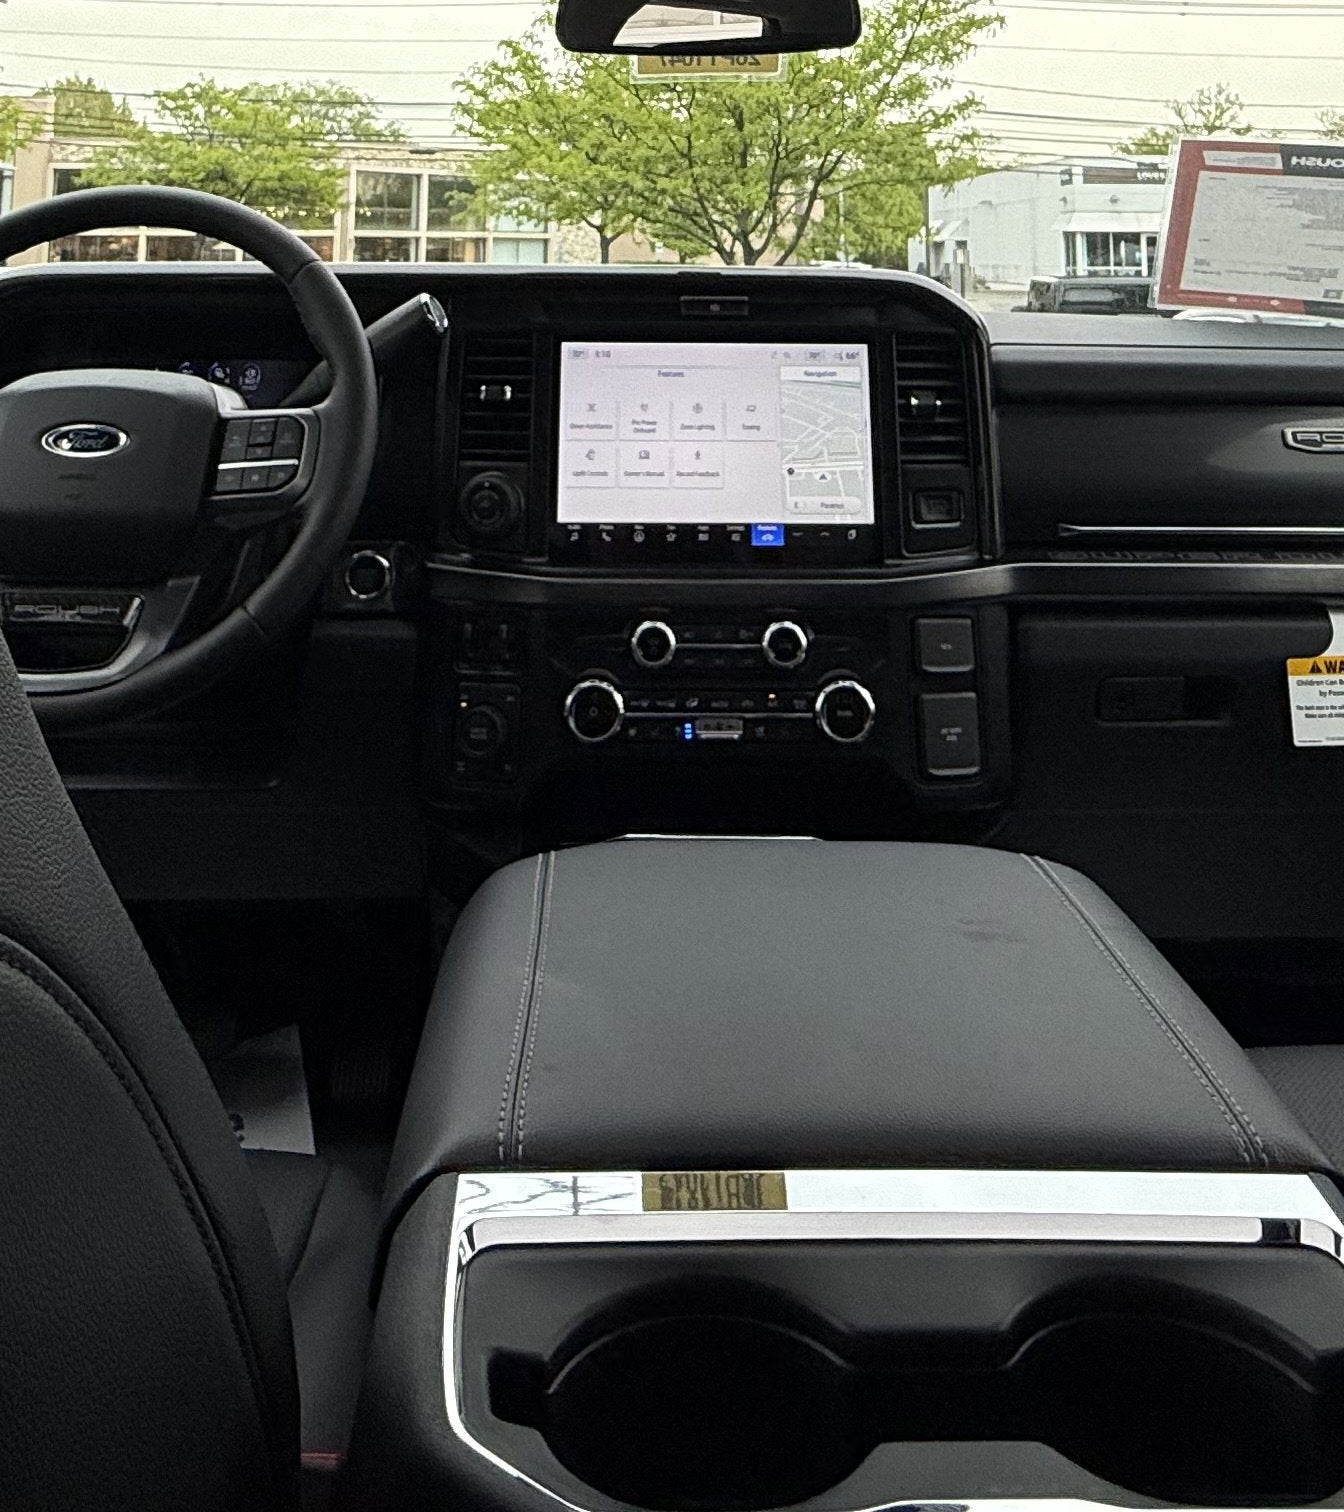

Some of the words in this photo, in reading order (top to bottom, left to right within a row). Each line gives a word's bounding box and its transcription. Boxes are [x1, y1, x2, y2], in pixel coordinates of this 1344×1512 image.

[804, 370, 837, 378] Navigation
[68, 430, 109, 449] Ford
[14, 603, 121, 616] ROUSH
[1296, 678, 1325, 686] Children
[1325, 678, 1338, 686] Can
[1319, 690, 1327, 698] by
